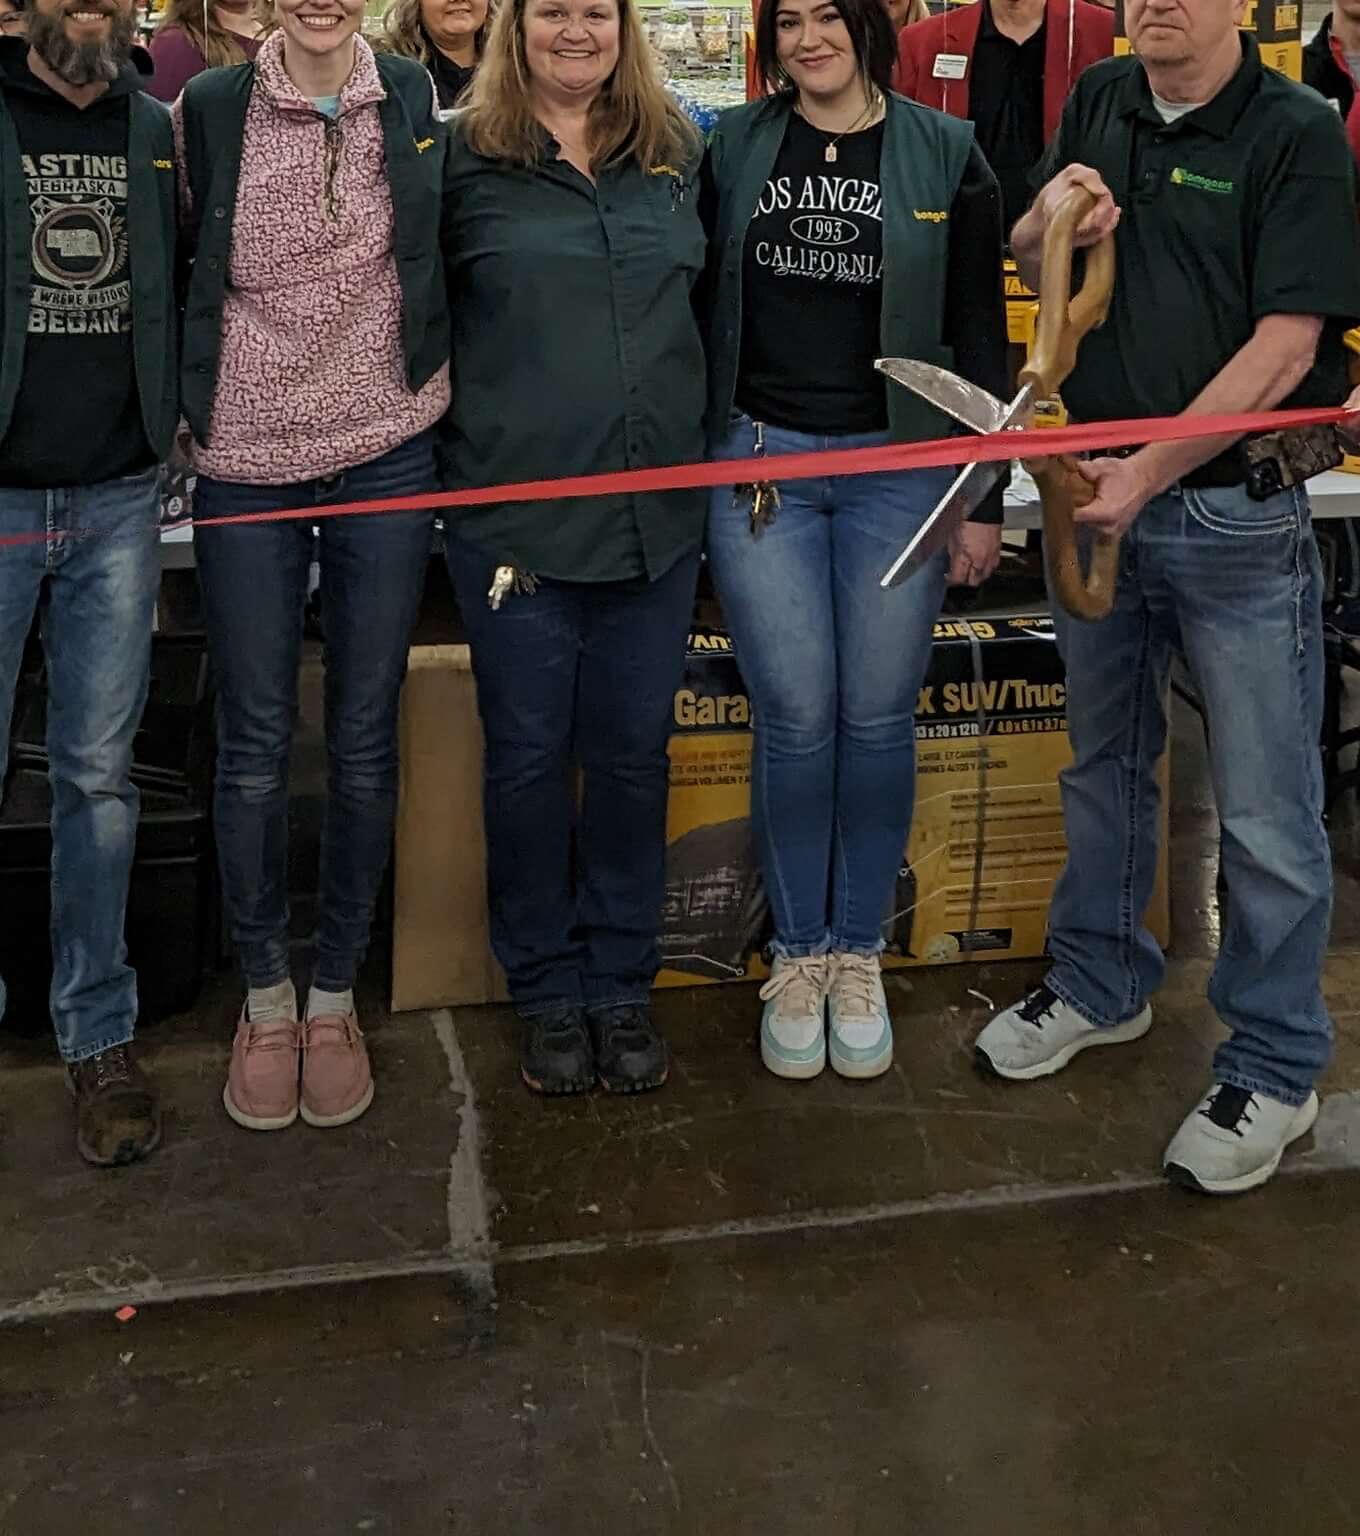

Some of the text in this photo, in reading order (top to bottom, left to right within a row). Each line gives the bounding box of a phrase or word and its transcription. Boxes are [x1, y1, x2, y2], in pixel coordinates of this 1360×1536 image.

[21, 154, 127, 178] ASTING
[28, 179, 117, 194] NEBRASKA
[752, 177, 791, 218] OS
[807, 219, 842, 243] 1993
[41, 288, 83, 306] WHERE
[27, 308, 120, 334] BEGAN
[943, 679, 1066, 713] SUV/Truc
